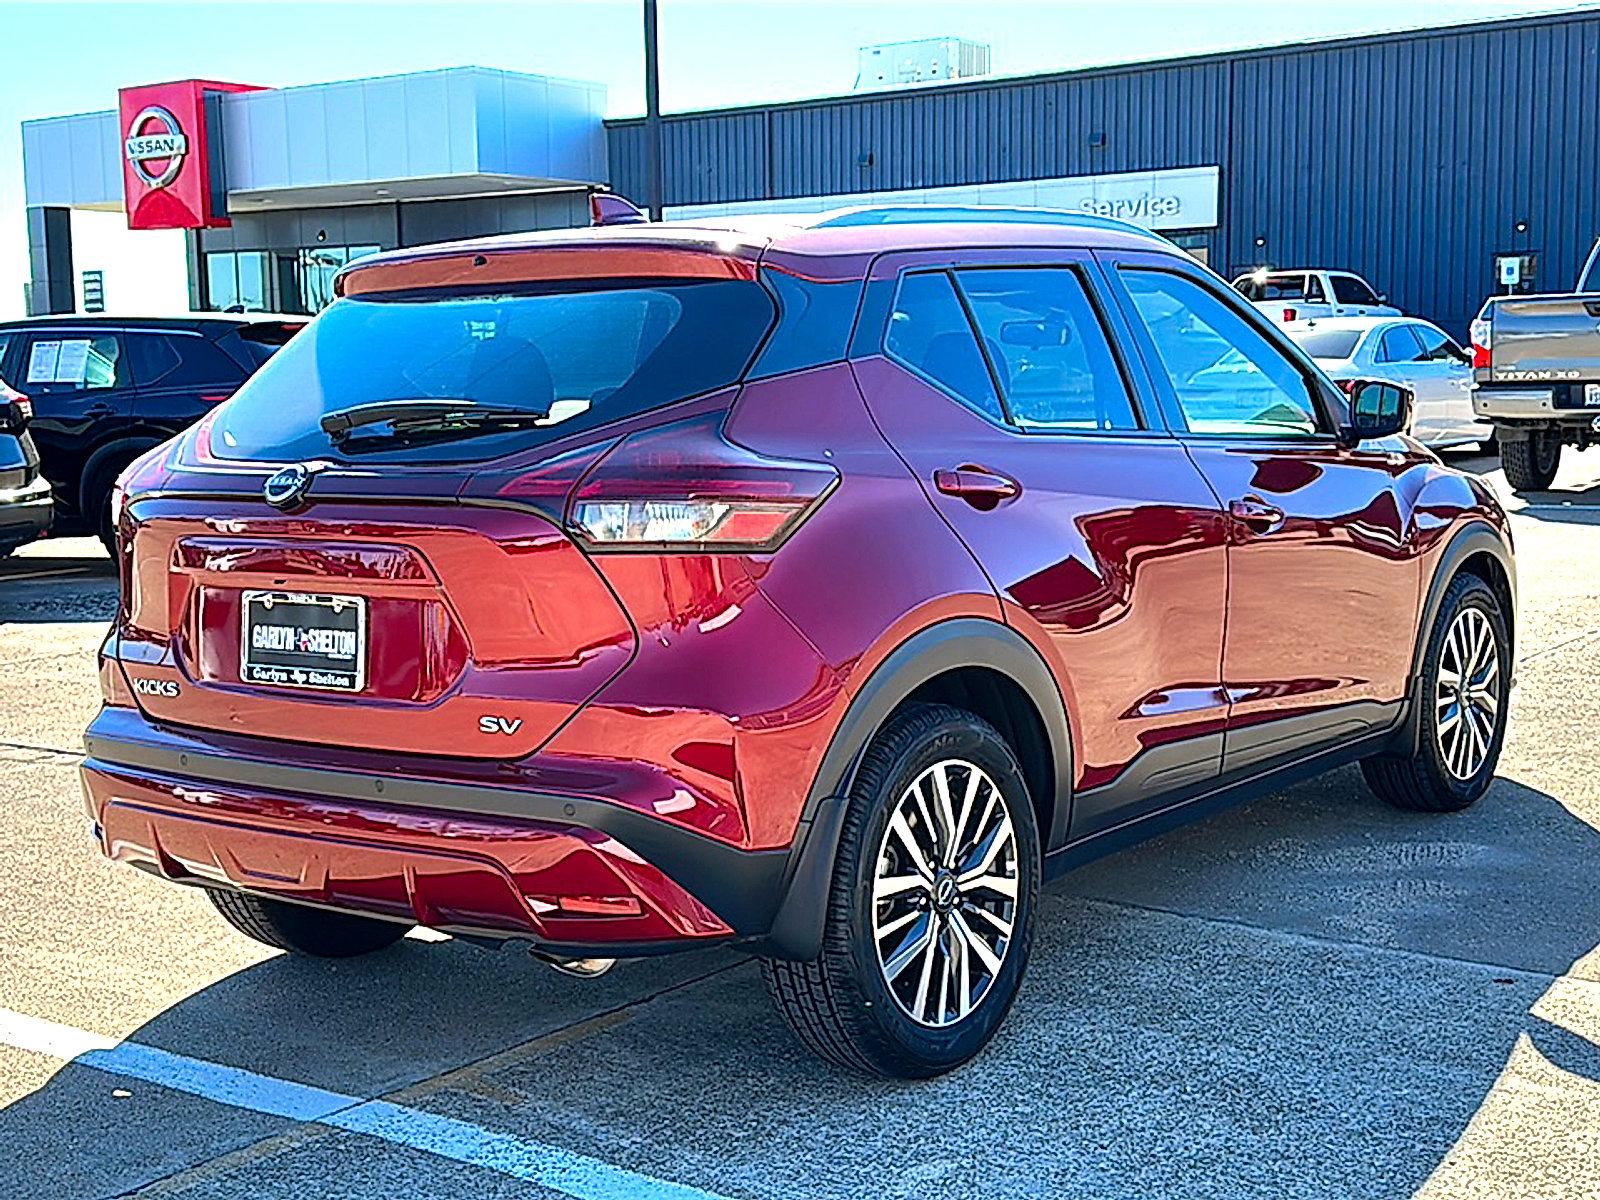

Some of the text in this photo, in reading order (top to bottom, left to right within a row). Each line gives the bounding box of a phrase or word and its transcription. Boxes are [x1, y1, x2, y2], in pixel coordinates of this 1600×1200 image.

[1080, 192, 1179, 218] Service
[1494, 370, 1551, 380] TITAN
[252, 624, 356, 655] GARLYN SHELTON
[133, 677, 180, 697] KICKS
[479, 716, 522, 735] SV
